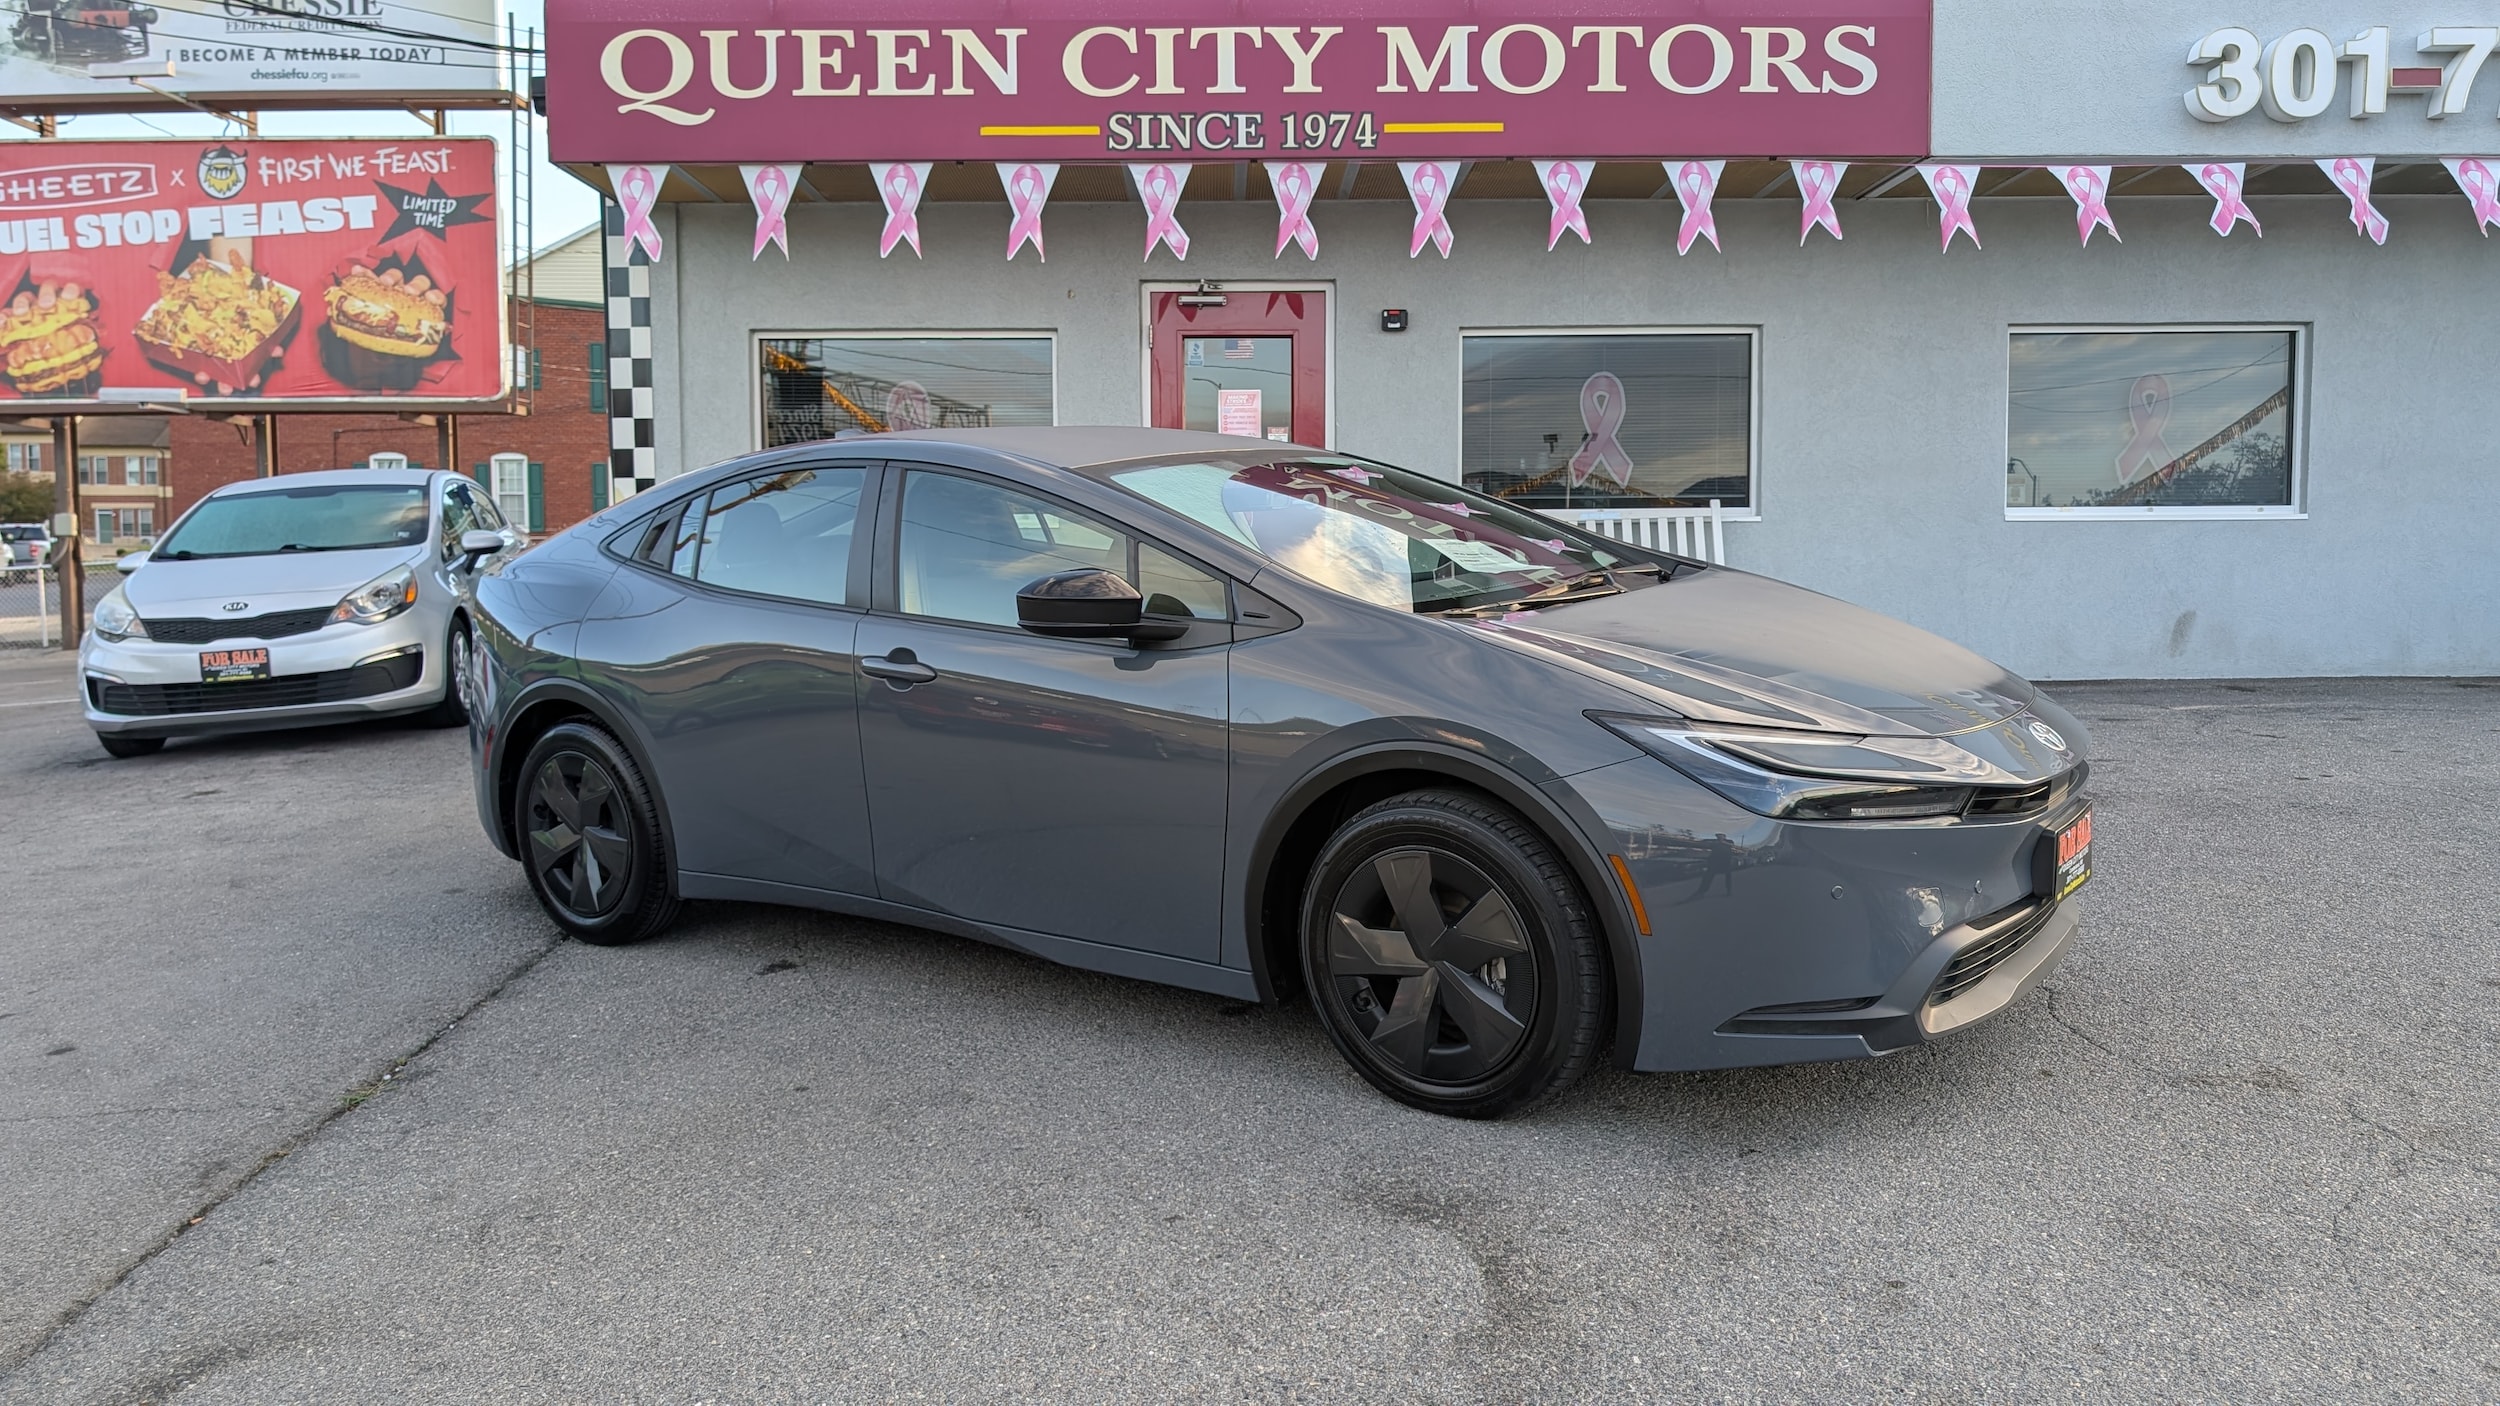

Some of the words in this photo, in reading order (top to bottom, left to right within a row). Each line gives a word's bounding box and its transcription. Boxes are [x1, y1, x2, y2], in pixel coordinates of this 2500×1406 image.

[223, 0, 383, 17] CHESSIE
[226, 21, 281, 31] FEDERAL
[180, 48, 256, 62] BECOME
[263, 48, 276, 61] A
[285, 48, 361, 61] MEMBER
[369, 48, 431, 61] TODAY
[250, 67, 328, 82] chessiefcu.org
[599, 27, 1027, 126] QUEEN
[1062, 25, 1344, 98] CITY
[1375, 23, 1879, 96] MOTORS
[2183, 26, 2500, 123] 301-7
[1107, 112, 1264, 151] SINCE
[1281, 111, 1377, 149] 1974
[258, 154, 325, 187] FIRST
[328, 152, 366, 180] WE
[369, 146, 452, 177] FEAST
[0, 170, 143, 201] HEETZ
[402, 195, 457, 213] LIMITED
[74, 209, 181, 249] STOP
[188, 195, 378, 241] FEAST
[413, 211, 445, 229] TIME
[225, 602, 246, 610] KIA
[201, 652, 230, 667] FOR
[231, 649, 267, 664] SALE
